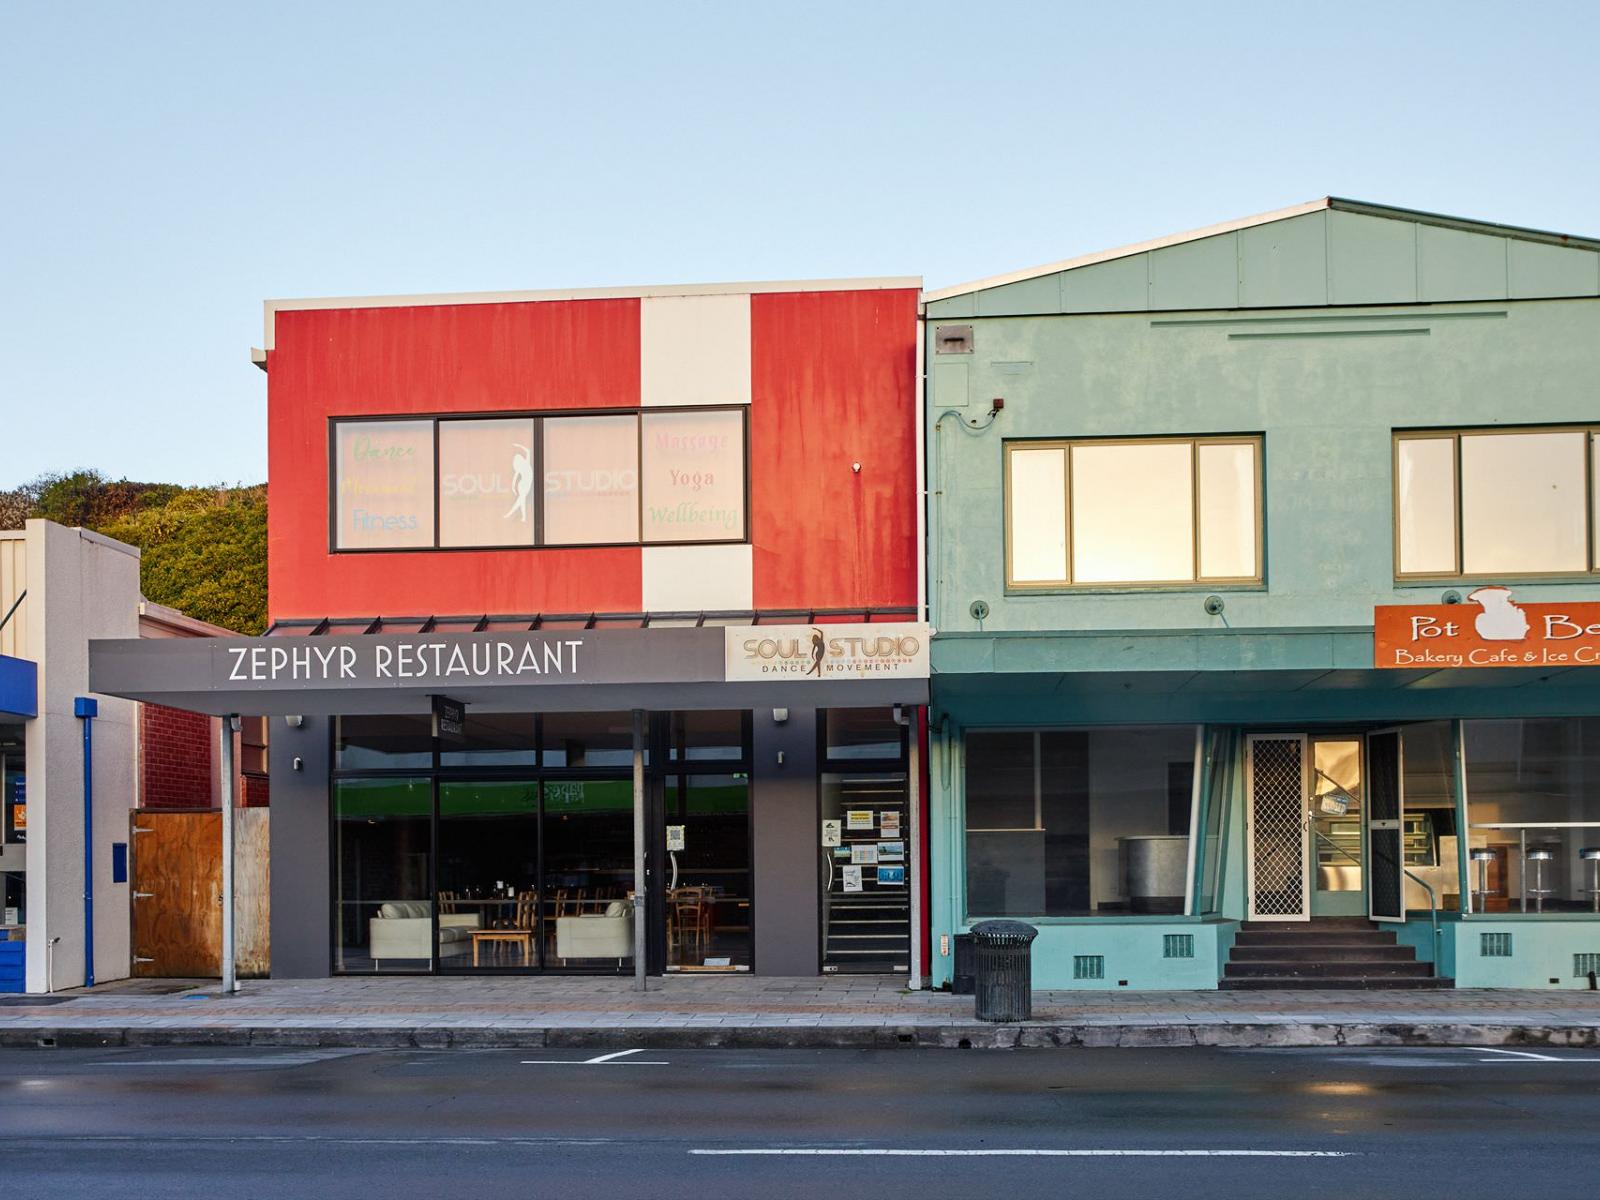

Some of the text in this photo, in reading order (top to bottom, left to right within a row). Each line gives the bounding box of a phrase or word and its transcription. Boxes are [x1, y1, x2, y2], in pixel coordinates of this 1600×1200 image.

[353, 434, 416, 462] Dance
[655, 431, 729, 453] Massage
[442, 472, 510, 495] SOUL
[544, 469, 636, 493] STUDIO
[669, 468, 715, 491] Yoga
[353, 508, 418, 531] Fitness
[648, 502, 738, 529] Wellbeing
[1409, 614, 1600, 641] Pot Be
[743, 636, 920, 659] SOUL STUDIO
[1394, 649, 1463, 666] Bakery
[1468, 648, 1518, 664] Cafe
[1523, 651, 1538, 662] &
[1542, 647, 1568, 663] Ice
[228, 640, 583, 680] ZEPHYR RESTAURANT
[762, 663, 900, 673] DANCE MOVEMENT
